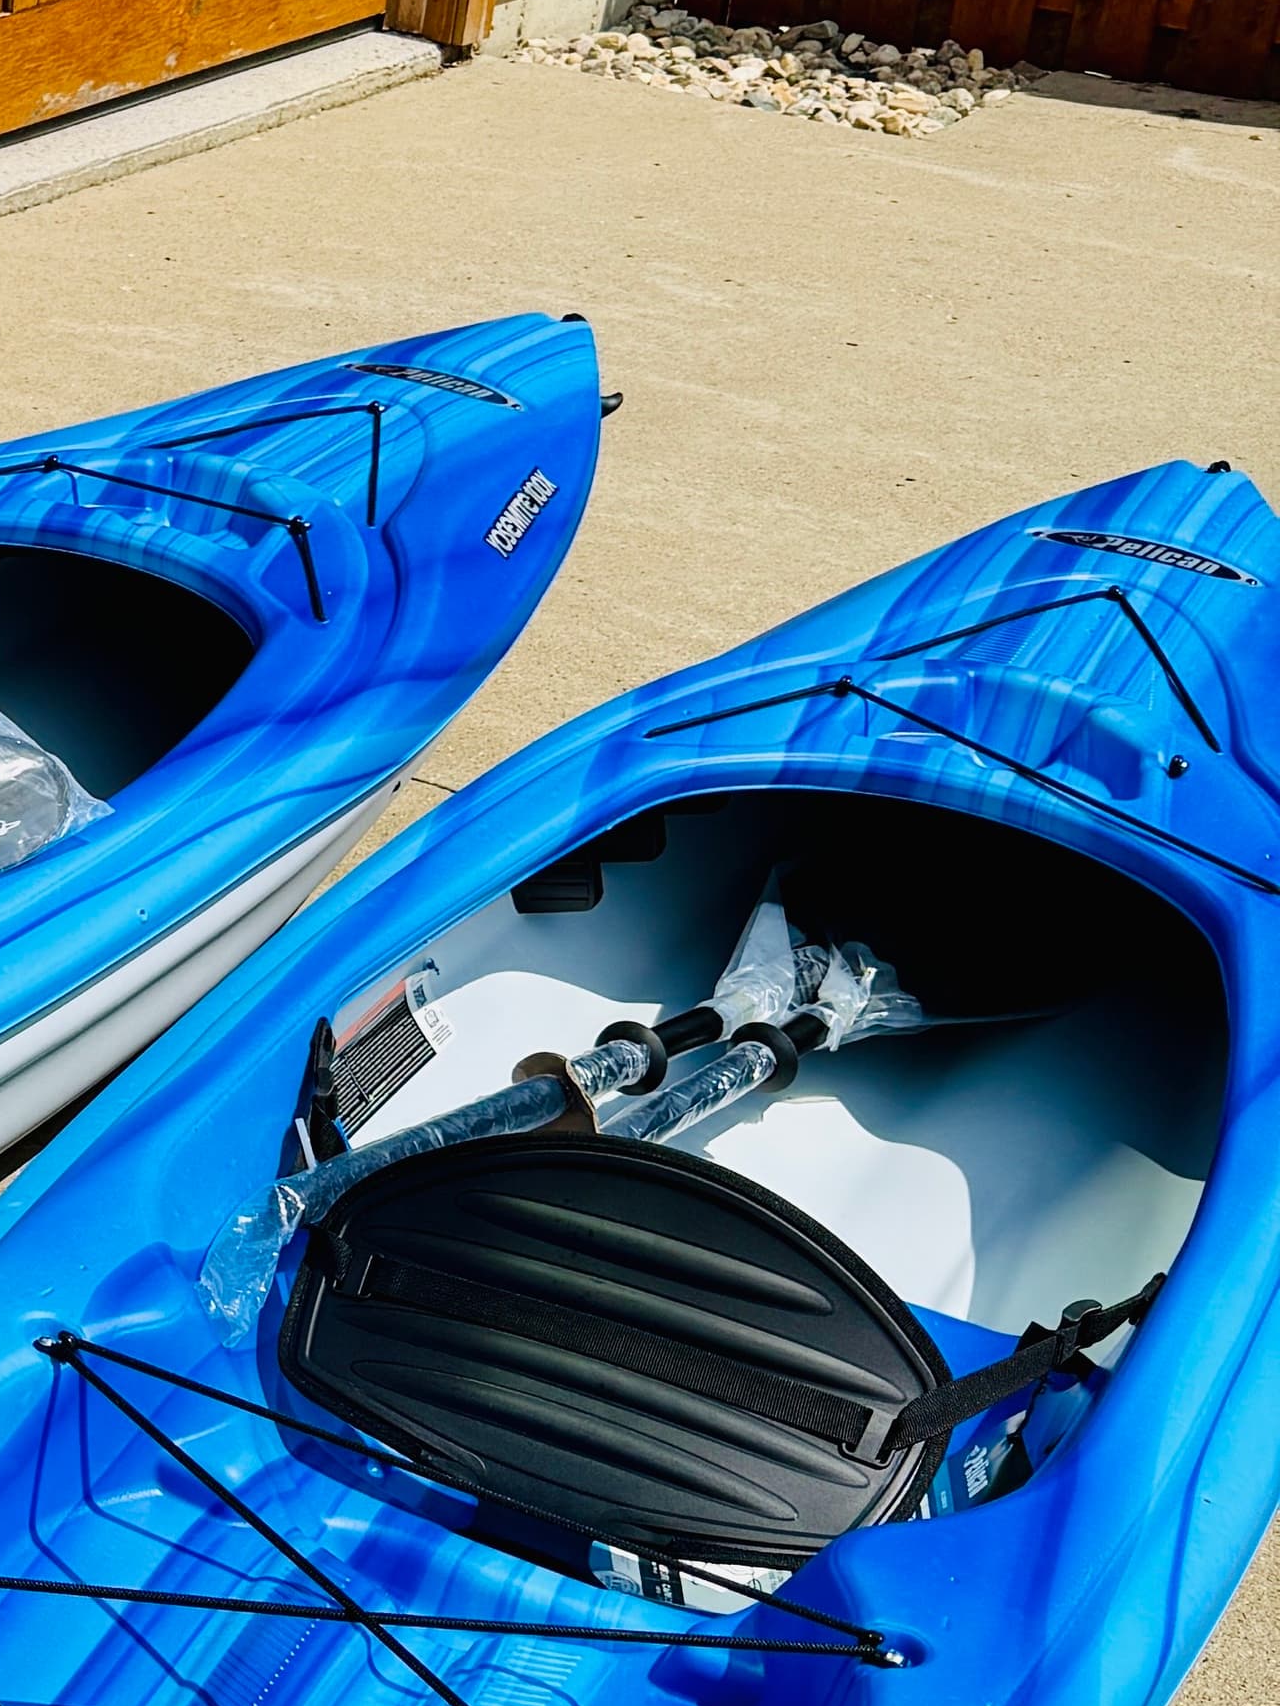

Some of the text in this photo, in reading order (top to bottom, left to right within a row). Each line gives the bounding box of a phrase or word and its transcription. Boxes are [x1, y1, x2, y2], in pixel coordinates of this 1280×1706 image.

[402, 367, 493, 398] Pelican
[485, 491, 540, 558] YOSEMITE
[1094, 536, 1222, 574] Pelican
